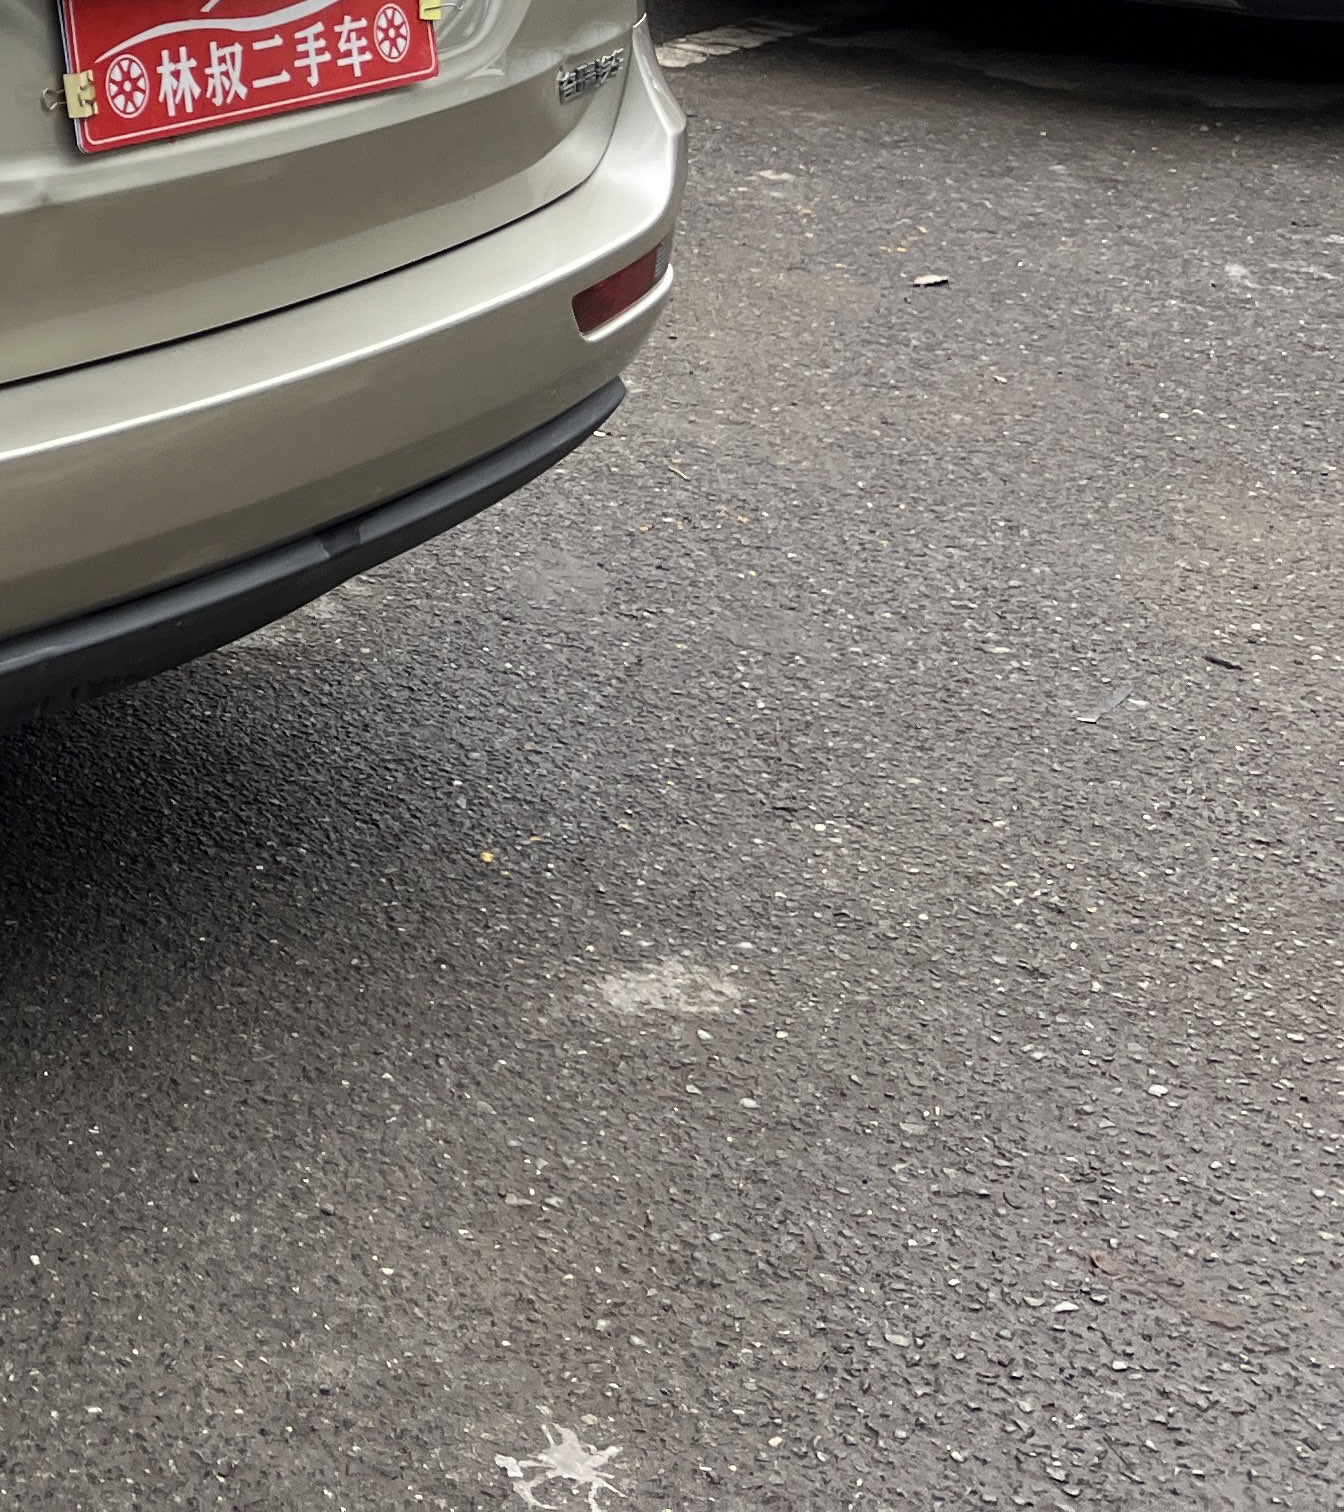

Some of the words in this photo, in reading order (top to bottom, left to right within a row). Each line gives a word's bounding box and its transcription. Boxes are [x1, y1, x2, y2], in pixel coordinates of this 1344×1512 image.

[156, 15, 373, 117] 林叔二手车
